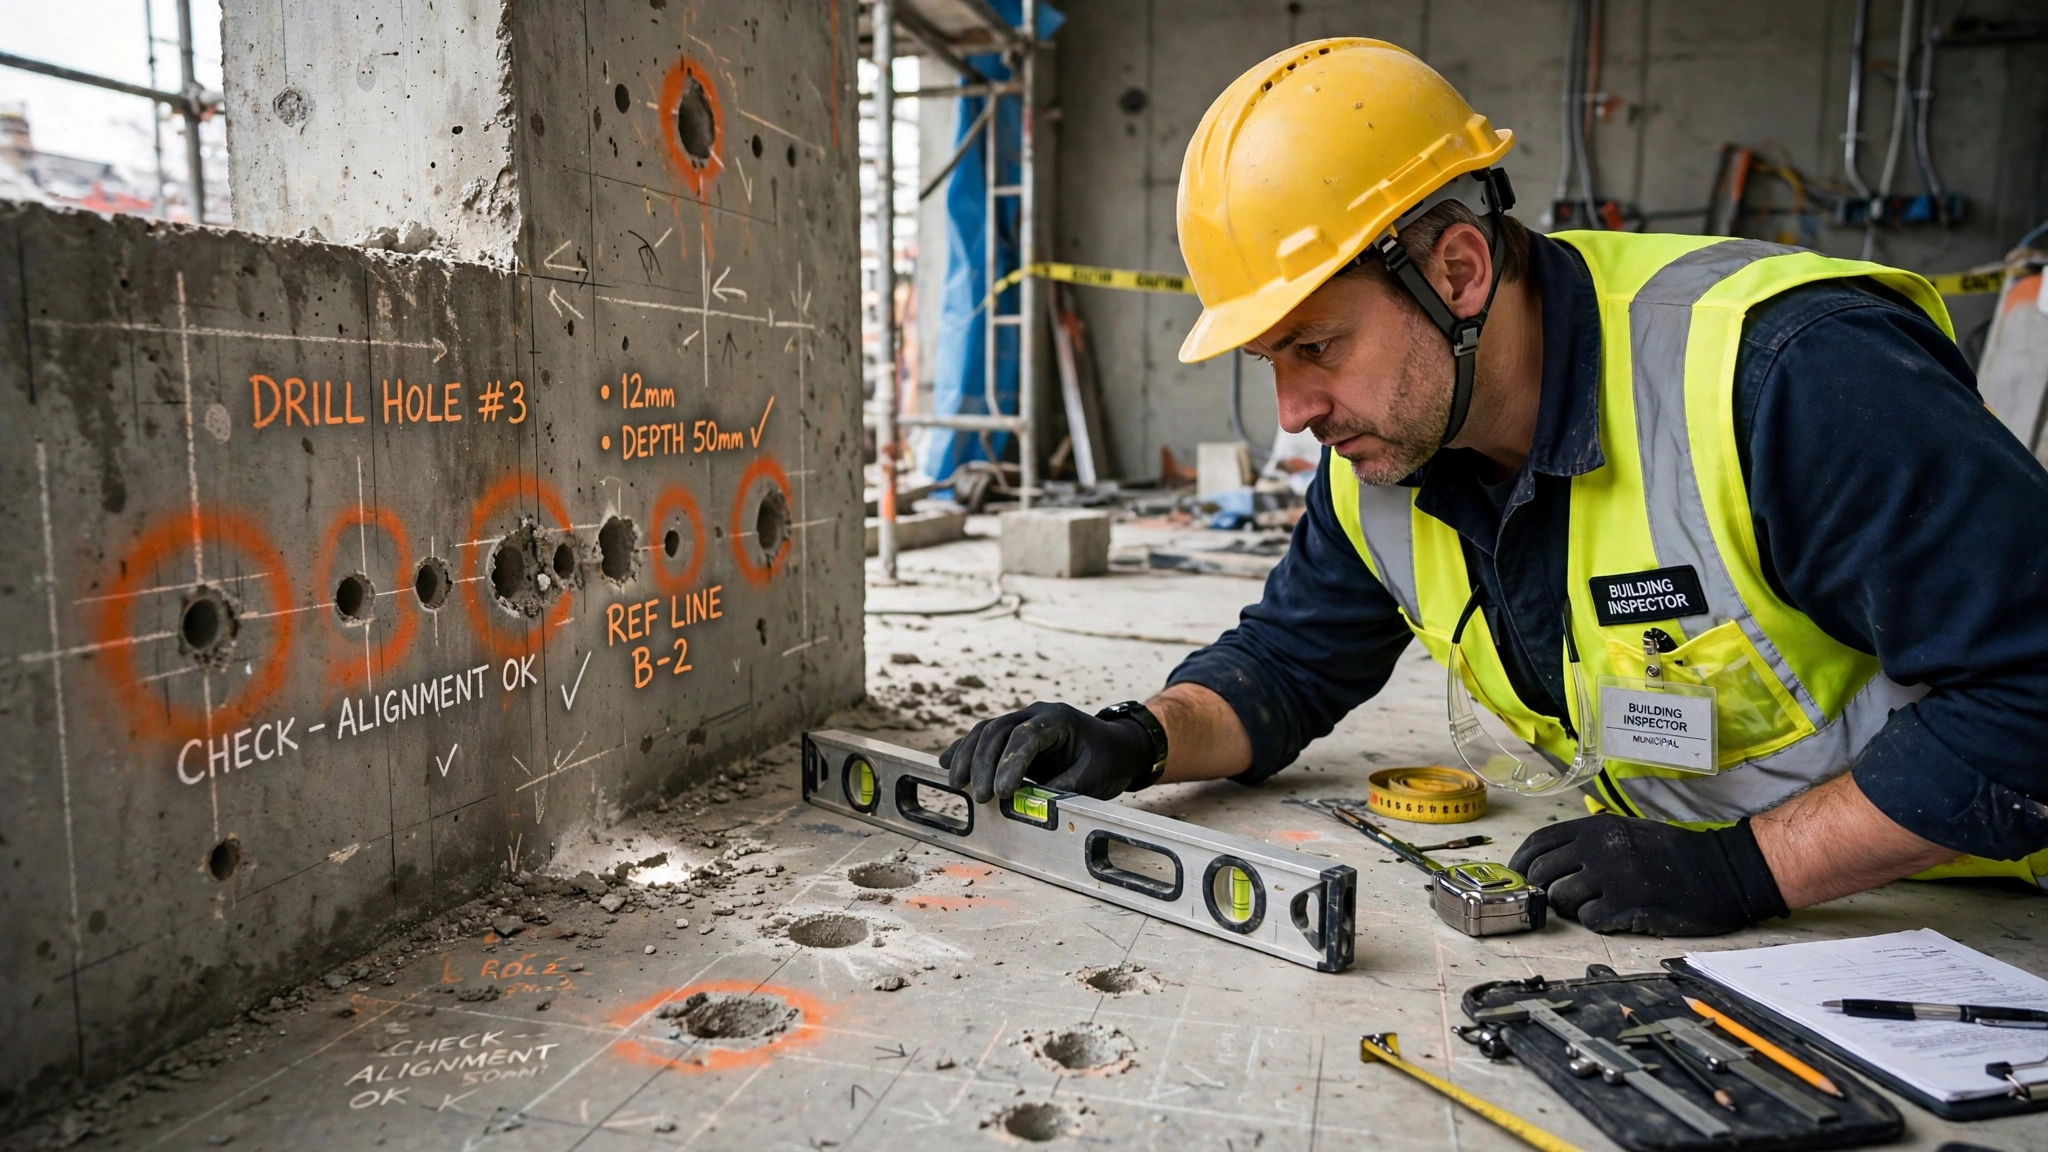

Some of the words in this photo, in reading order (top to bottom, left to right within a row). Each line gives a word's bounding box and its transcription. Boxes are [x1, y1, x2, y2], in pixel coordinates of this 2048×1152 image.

[249, 374, 365, 429] DRILL
[383, 378, 462, 425] HOLE
[478, 380, 527, 424] #3
[622, 372, 675, 409] 12mm
[622, 421, 684, 460] DEPTH
[693, 420, 743, 453] 50mm
[1608, 578, 1674, 598] BUILDING
[606, 601, 659, 647] REF
[671, 585, 723, 629] LINE
[1607, 593, 1689, 615] INSPECTOR
[631, 637, 692, 689] B-2
[177, 717, 298, 785] CHECK
[337, 664, 490, 739] ALIGNMENT
[502, 654, 538, 691] OK
[1623, 715, 1688, 732] INSPECTOR
[1628, 703, 1682, 718] BUILDING
[1633, 735, 1680, 749] MUNICIPAL
[381, 1031, 504, 1057] CHECK
[344, 1043, 560, 1086] ALIGNMENT
[349, 1087, 411, 1110] OK
